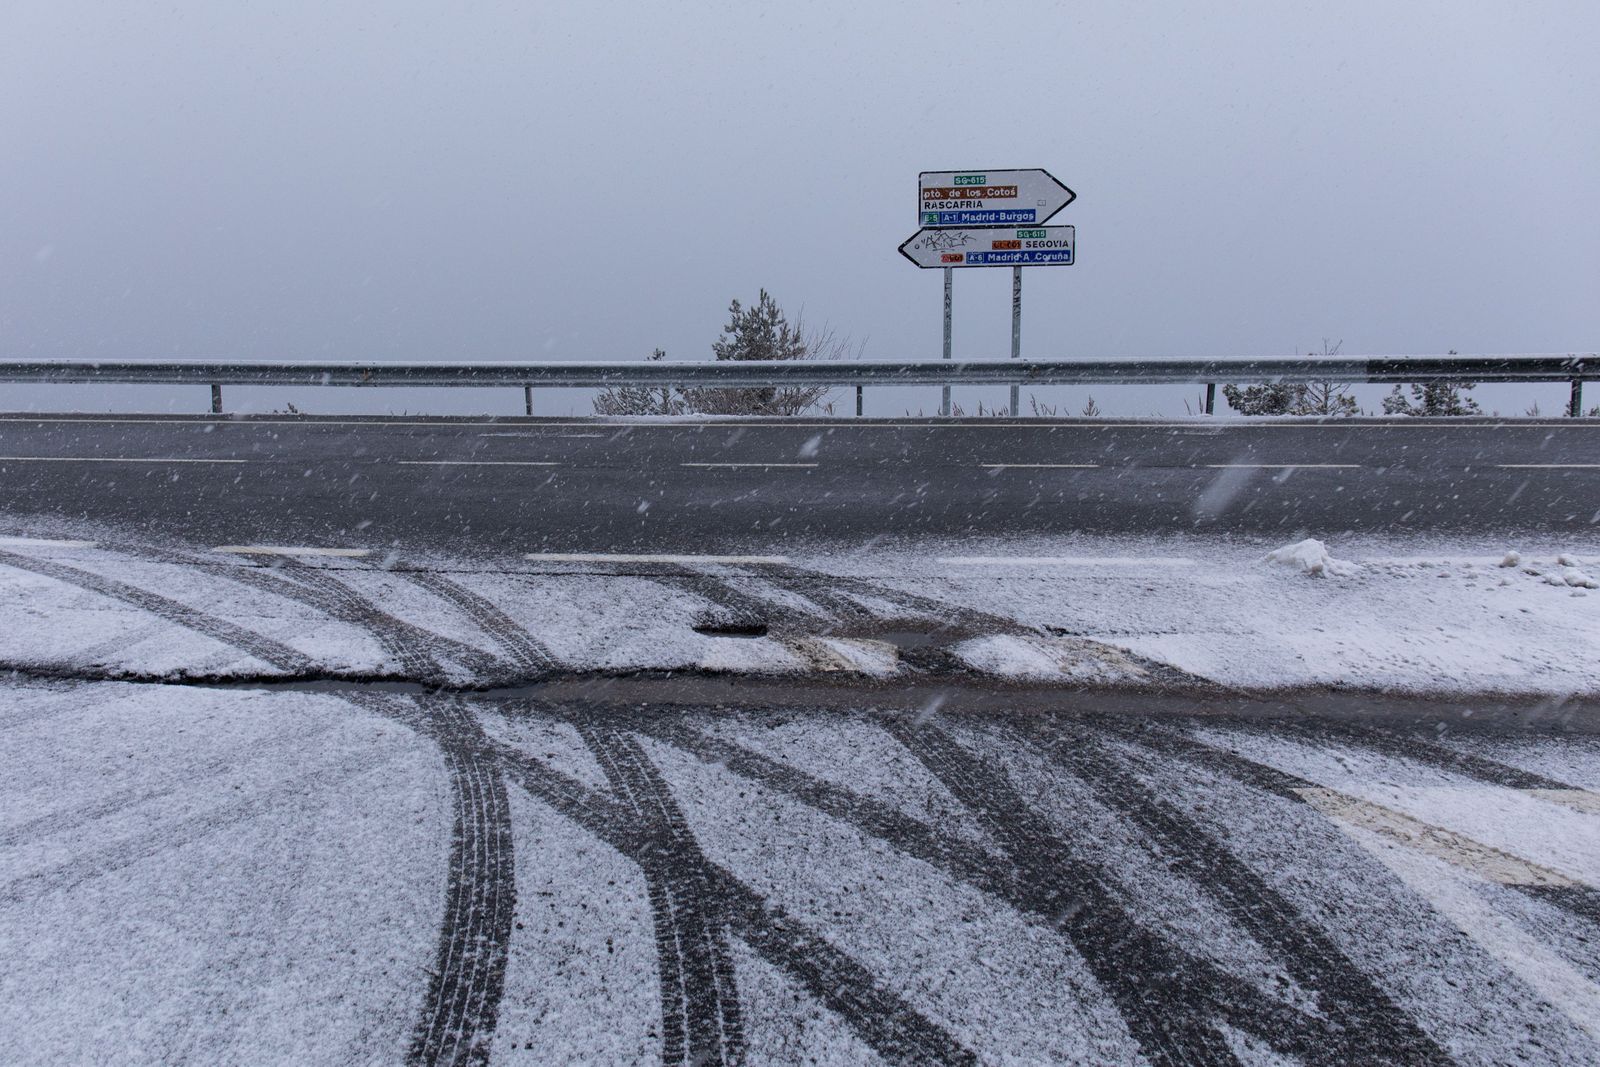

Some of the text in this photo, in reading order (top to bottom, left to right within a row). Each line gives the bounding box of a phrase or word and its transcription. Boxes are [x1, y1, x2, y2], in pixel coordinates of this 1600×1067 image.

[955, 176, 985, 184] SG-615
[949, 189, 961, 197] de
[966, 188, 981, 196] los
[987, 187, 1016, 196] Cotos
[961, 212, 1034, 221] Madrid-Burgos
[1025, 240, 1069, 248] SEGOVIA
